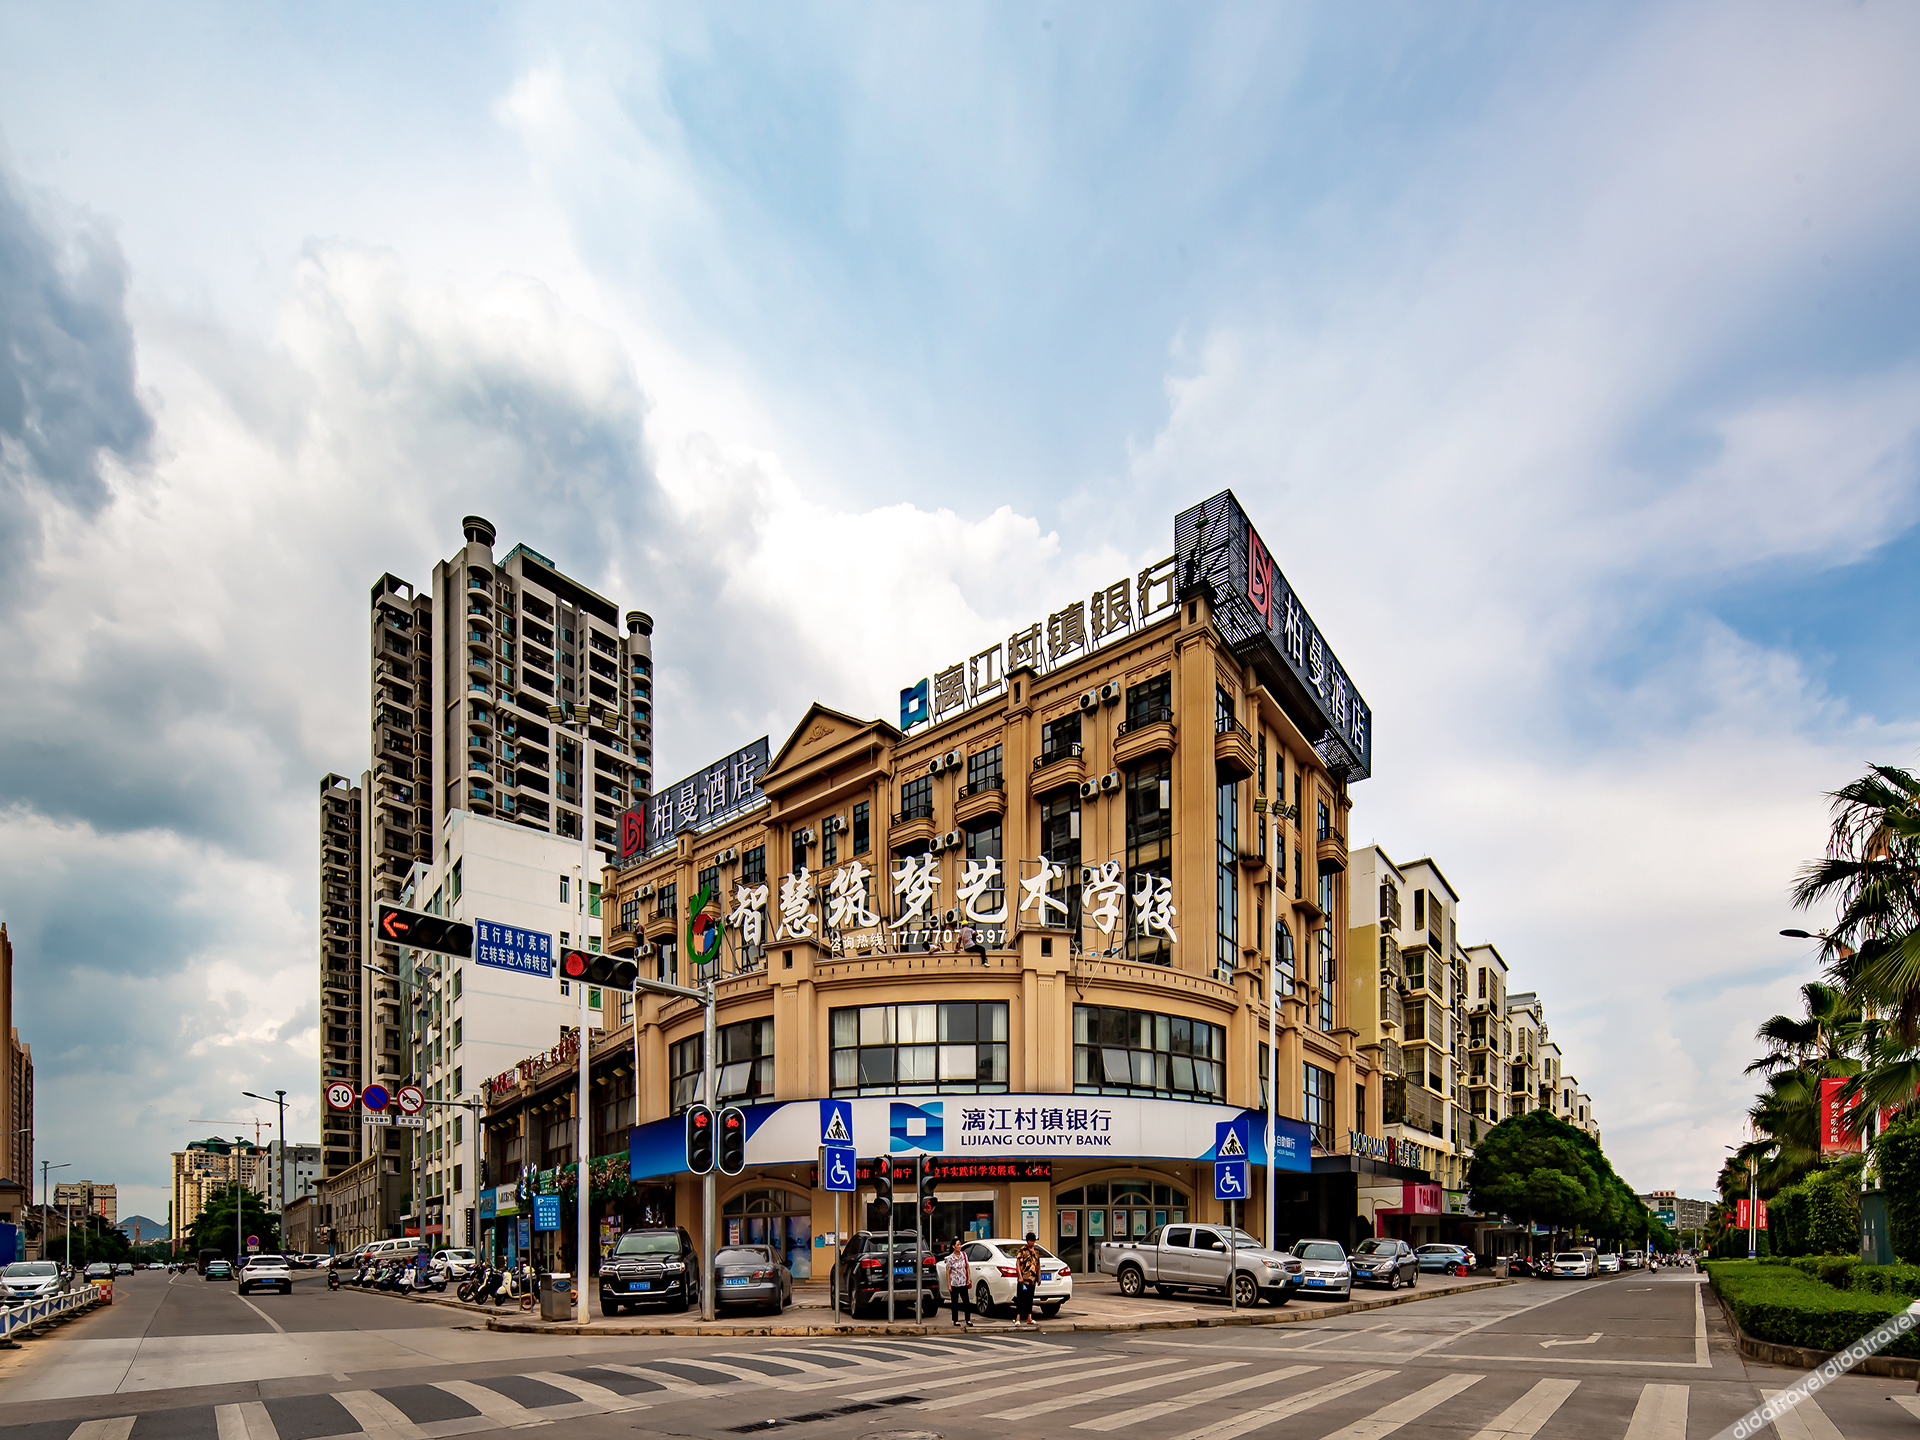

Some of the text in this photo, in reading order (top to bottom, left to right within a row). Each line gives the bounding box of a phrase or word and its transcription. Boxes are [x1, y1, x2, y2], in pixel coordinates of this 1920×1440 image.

[934, 567, 1176, 715] 漓江村镇银行
[1285, 592, 1365, 754] 柏曼酒店
[652, 753, 757, 839] 柏曼酒店
[728, 852, 1178, 946] 智慧筑梦艺术学校
[480, 924, 548, 953] 直行绿灯亮时
[480, 944, 548, 973] 左转车进入待转区
[332, 1089, 350, 1103] 30
[961, 1107, 1112, 1131] 漓江村镇银行
[961, 1134, 1112, 1146] LIJIANG COUNTY BANK
[1353, 1131, 1389, 1158] BORRMAN
